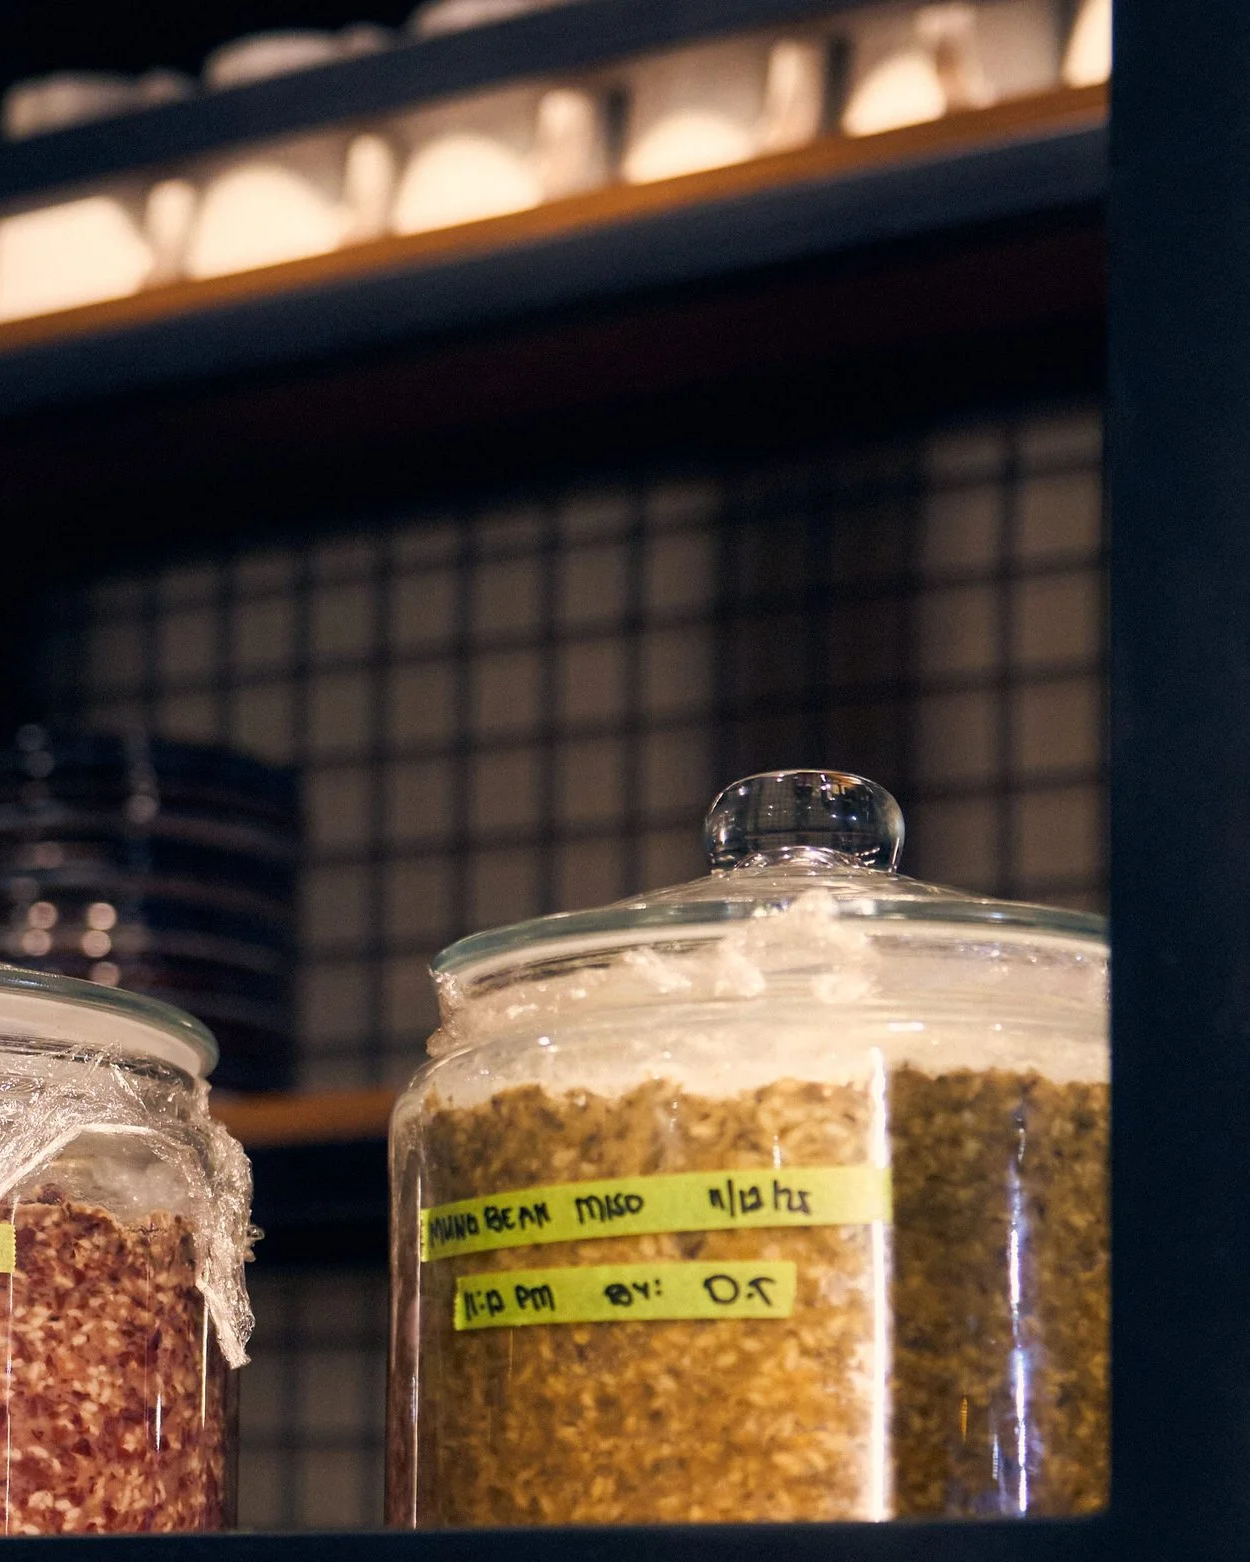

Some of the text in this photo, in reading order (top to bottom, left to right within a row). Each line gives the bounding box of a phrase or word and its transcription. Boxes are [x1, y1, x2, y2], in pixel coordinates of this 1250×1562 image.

[484, 1202, 551, 1233] BEAN
[574, 1192, 644, 1224] MISO
[515, 1284, 555, 1311] PM
